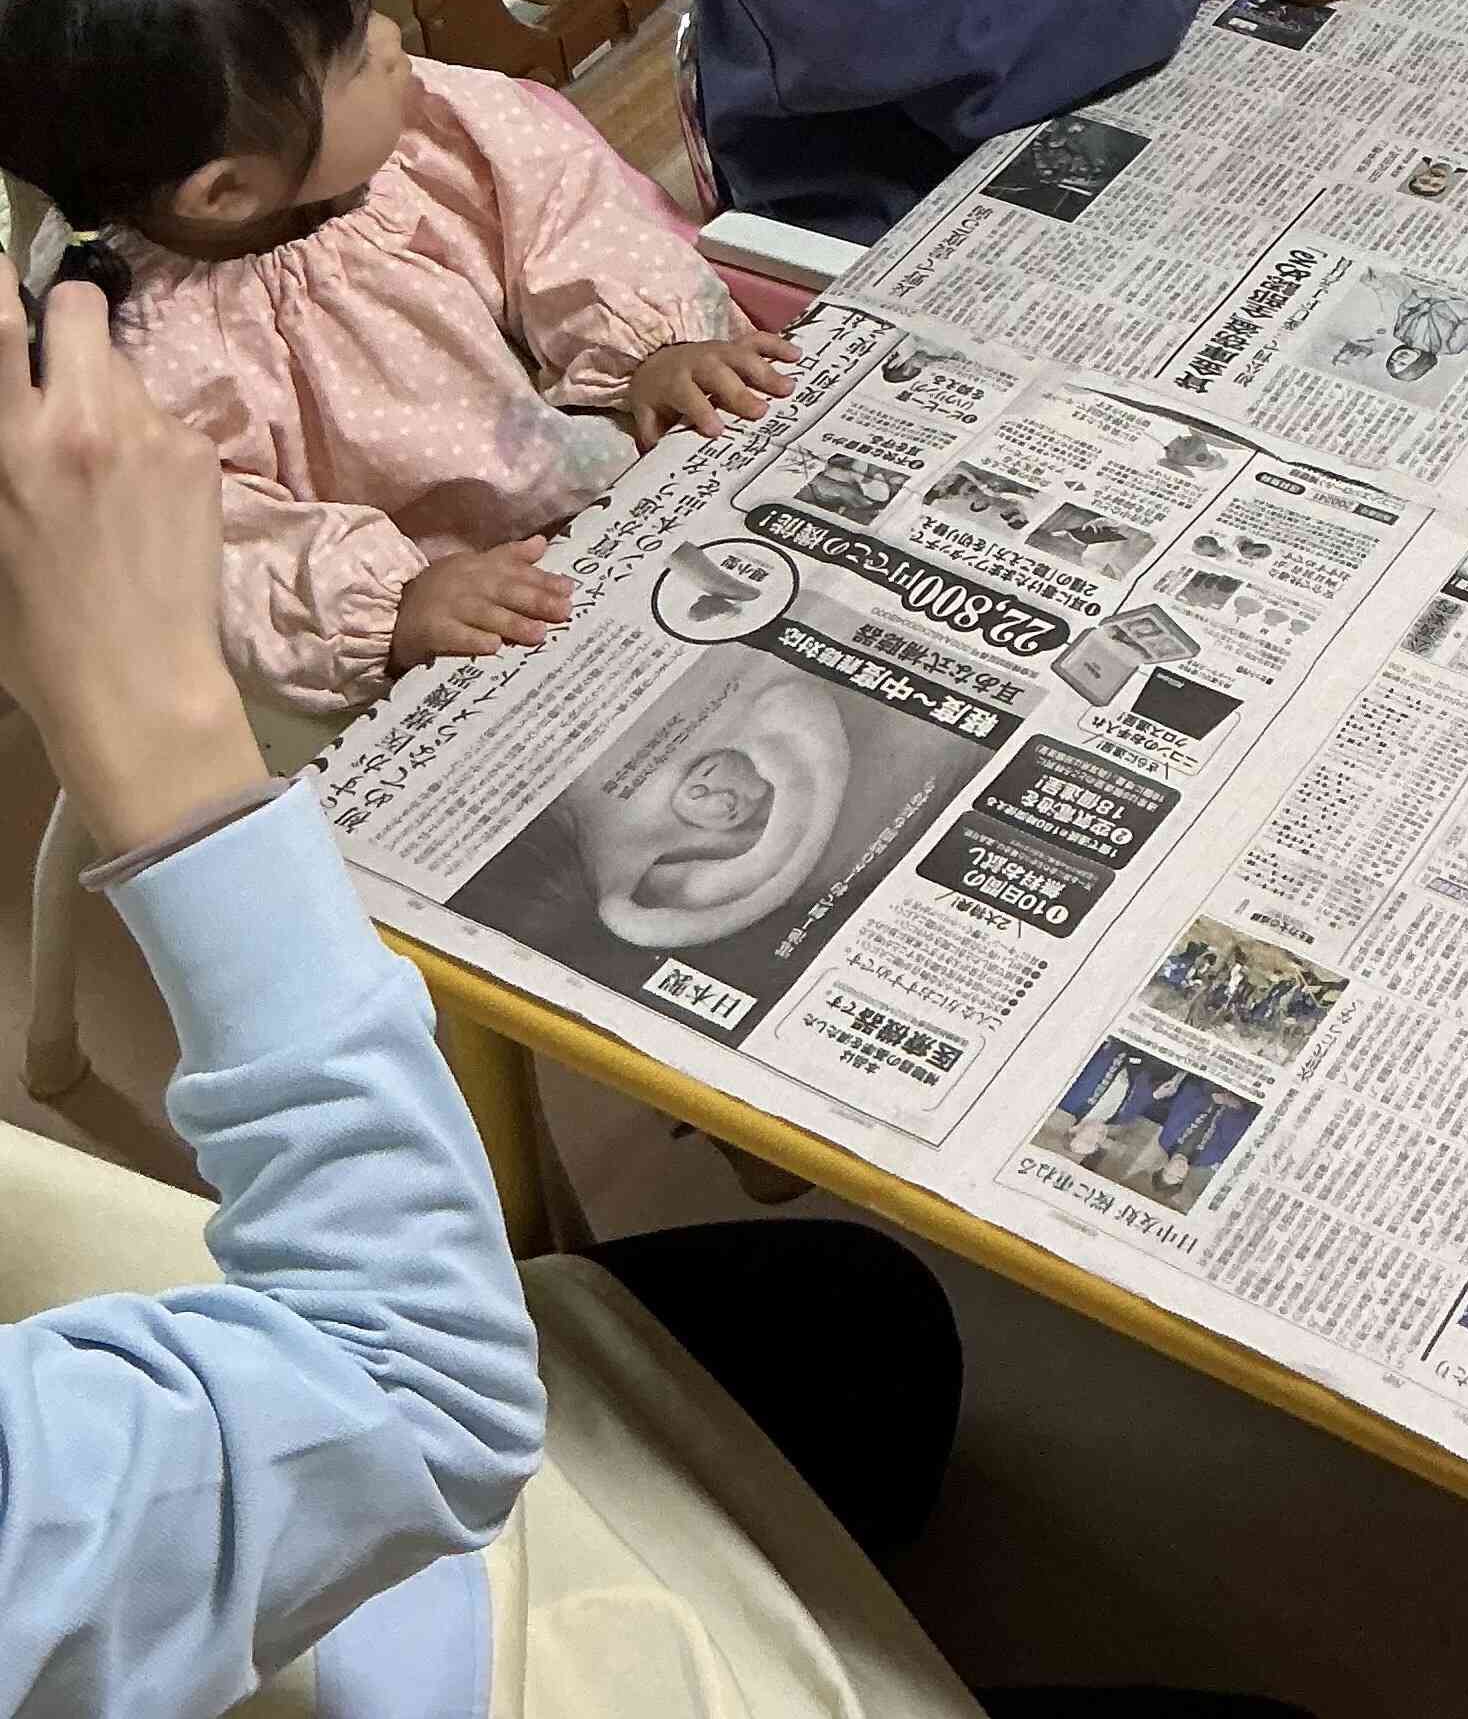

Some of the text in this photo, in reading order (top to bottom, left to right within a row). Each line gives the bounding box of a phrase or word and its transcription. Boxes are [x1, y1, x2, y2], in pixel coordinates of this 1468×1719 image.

[718, 555, 770, 582] 超小型
[849, 621, 1026, 704] 耳あな式補聴器
[1087, 715, 1199, 768] ニコンのお手入れ
[961, 843, 1066, 900] 無料お試し
[656, 967, 742, 1019] 日本製
[1012, 1152, 1199, 1255] 日中友好 桜に重ねる
